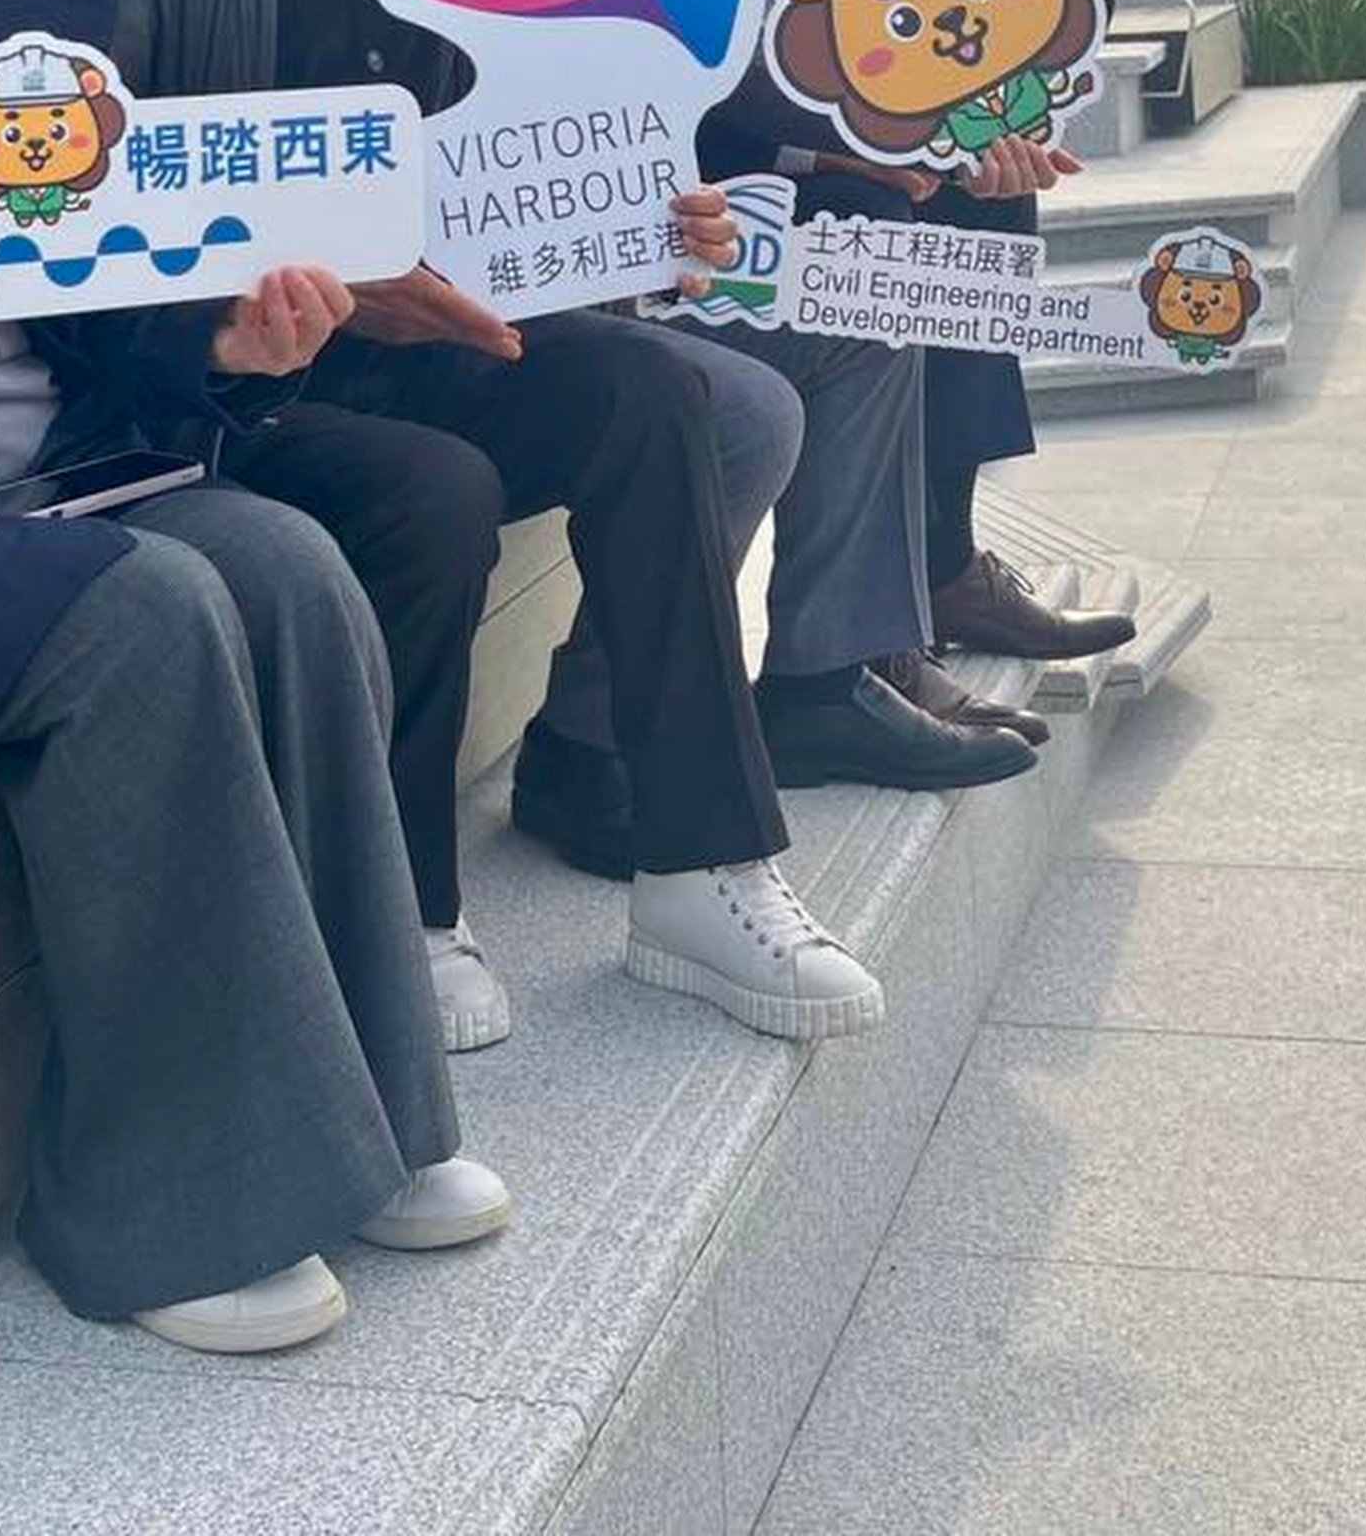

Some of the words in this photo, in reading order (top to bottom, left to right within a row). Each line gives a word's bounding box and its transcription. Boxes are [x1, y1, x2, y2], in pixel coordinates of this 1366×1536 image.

[126, 109, 399, 193] 暢踏西東
[437, 102, 671, 178] VICTORIA
[440, 159, 681, 240] HARBOUR
[487, 221, 688, 297] 維多利亞港
[806, 220, 1040, 279] 土木工程拓展署
[798, 297, 981, 343] Development
[988, 324, 1145, 360] Department
[801, 264, 861, 297] Civil
[869, 271, 1032, 320] Engineering
[1040, 295, 1091, 321] and
